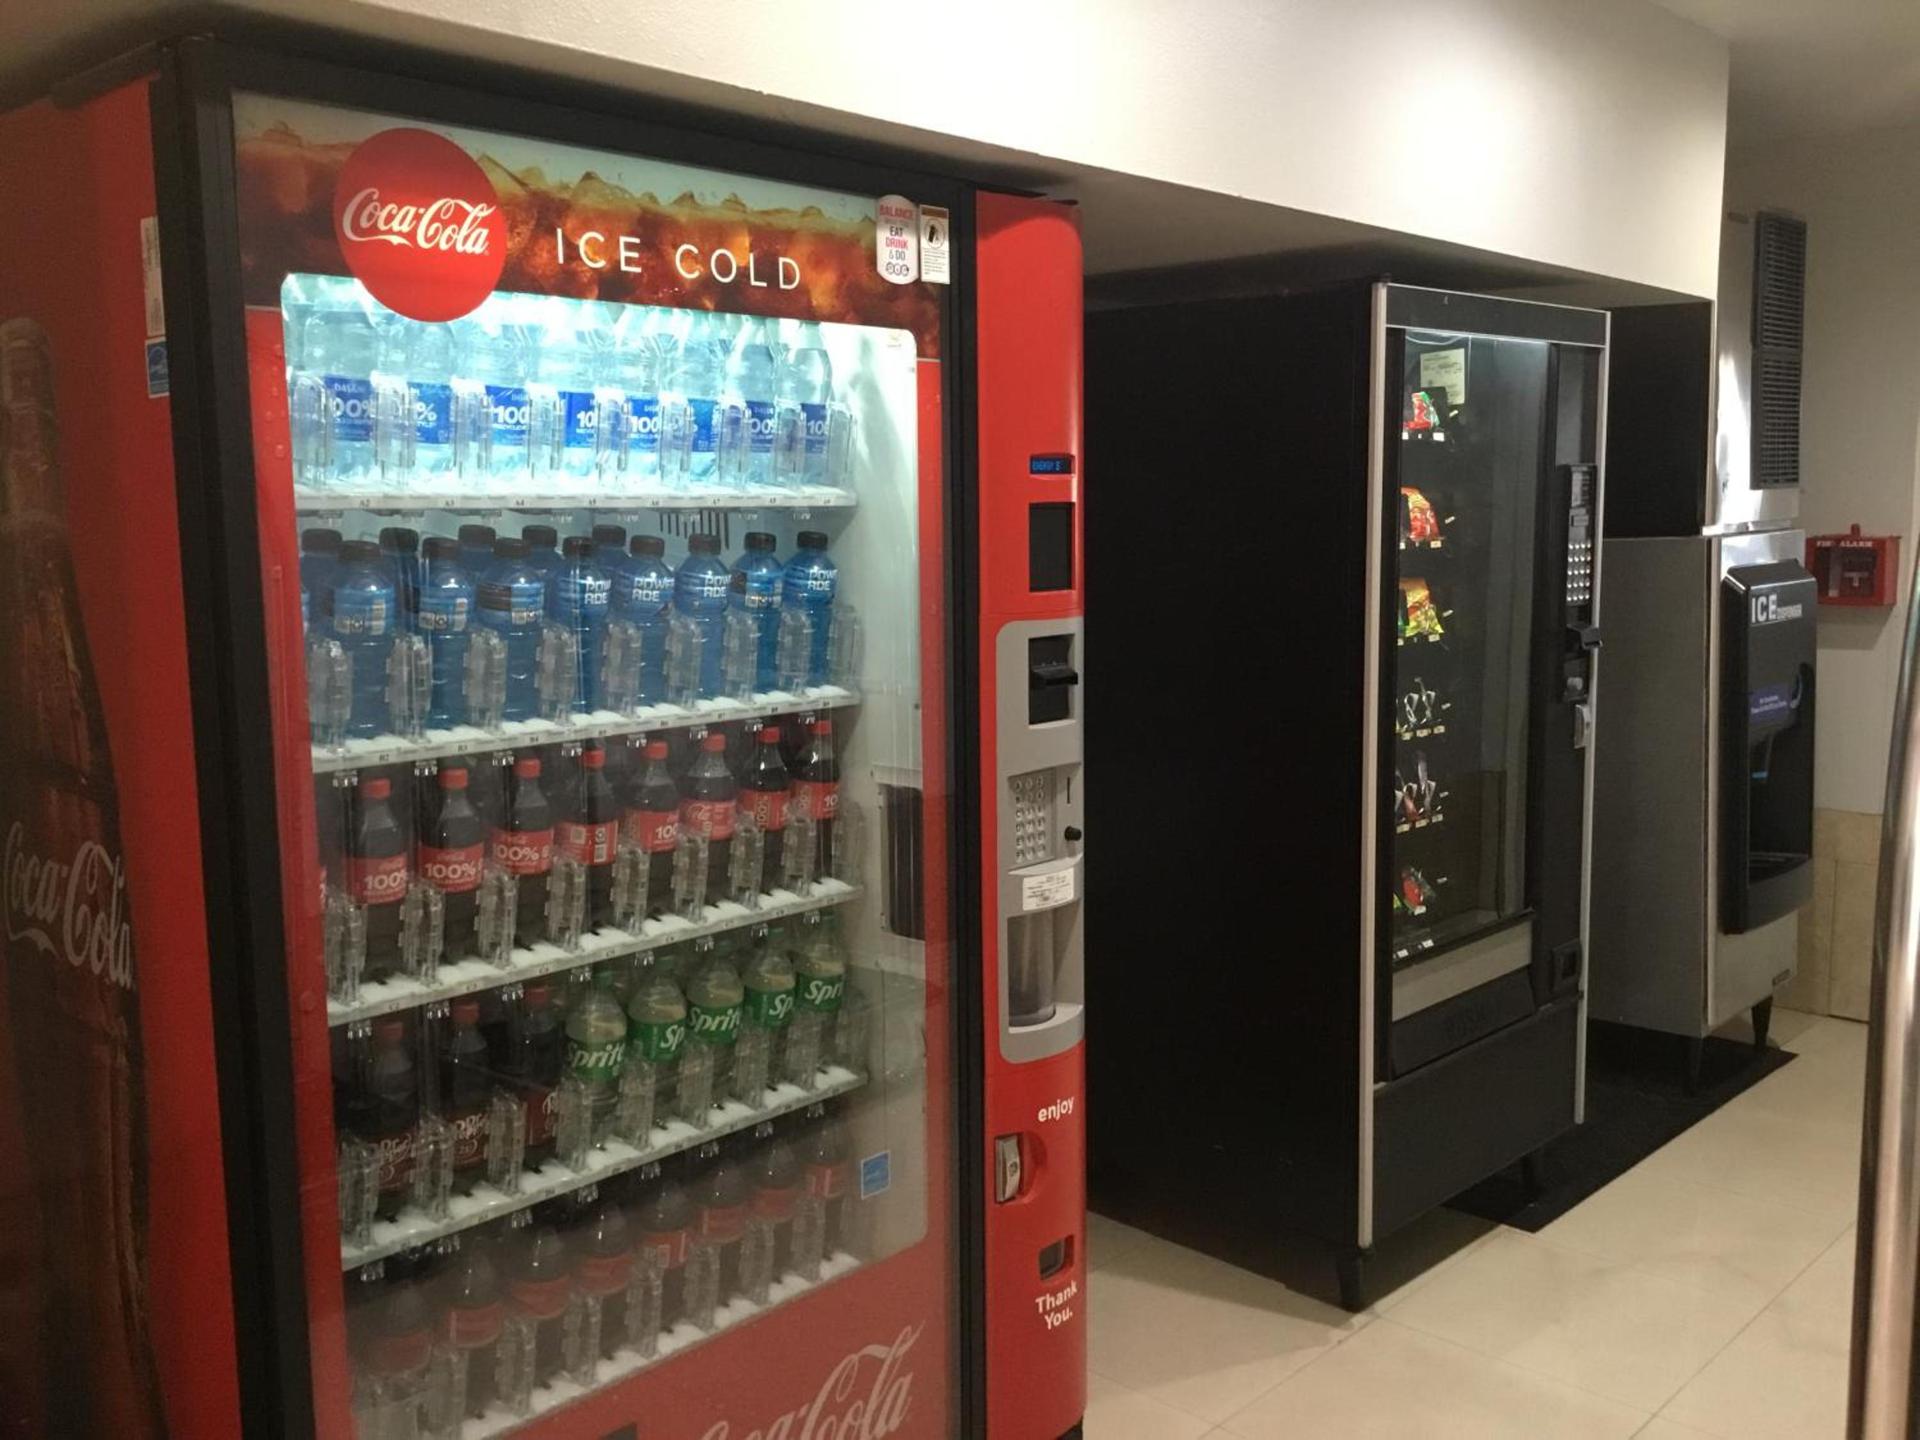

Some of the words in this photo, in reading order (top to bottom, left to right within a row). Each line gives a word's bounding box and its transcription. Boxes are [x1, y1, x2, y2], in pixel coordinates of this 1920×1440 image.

[342, 187, 497, 255] Coca-Cola
[889, 226, 904, 237] EAT
[885, 237, 908, 249] DRINK
[556, 227, 643, 274] ICE
[674, 243, 801, 290] COLD
[1751, 593, 1778, 623] ICE
[1037, 1096, 1075, 1122] enjoy
[1034, 1280, 1078, 1315] Thank
[1043, 1308, 1074, 1332] You.
[698, 1319, 926, 1440] a-Cola
